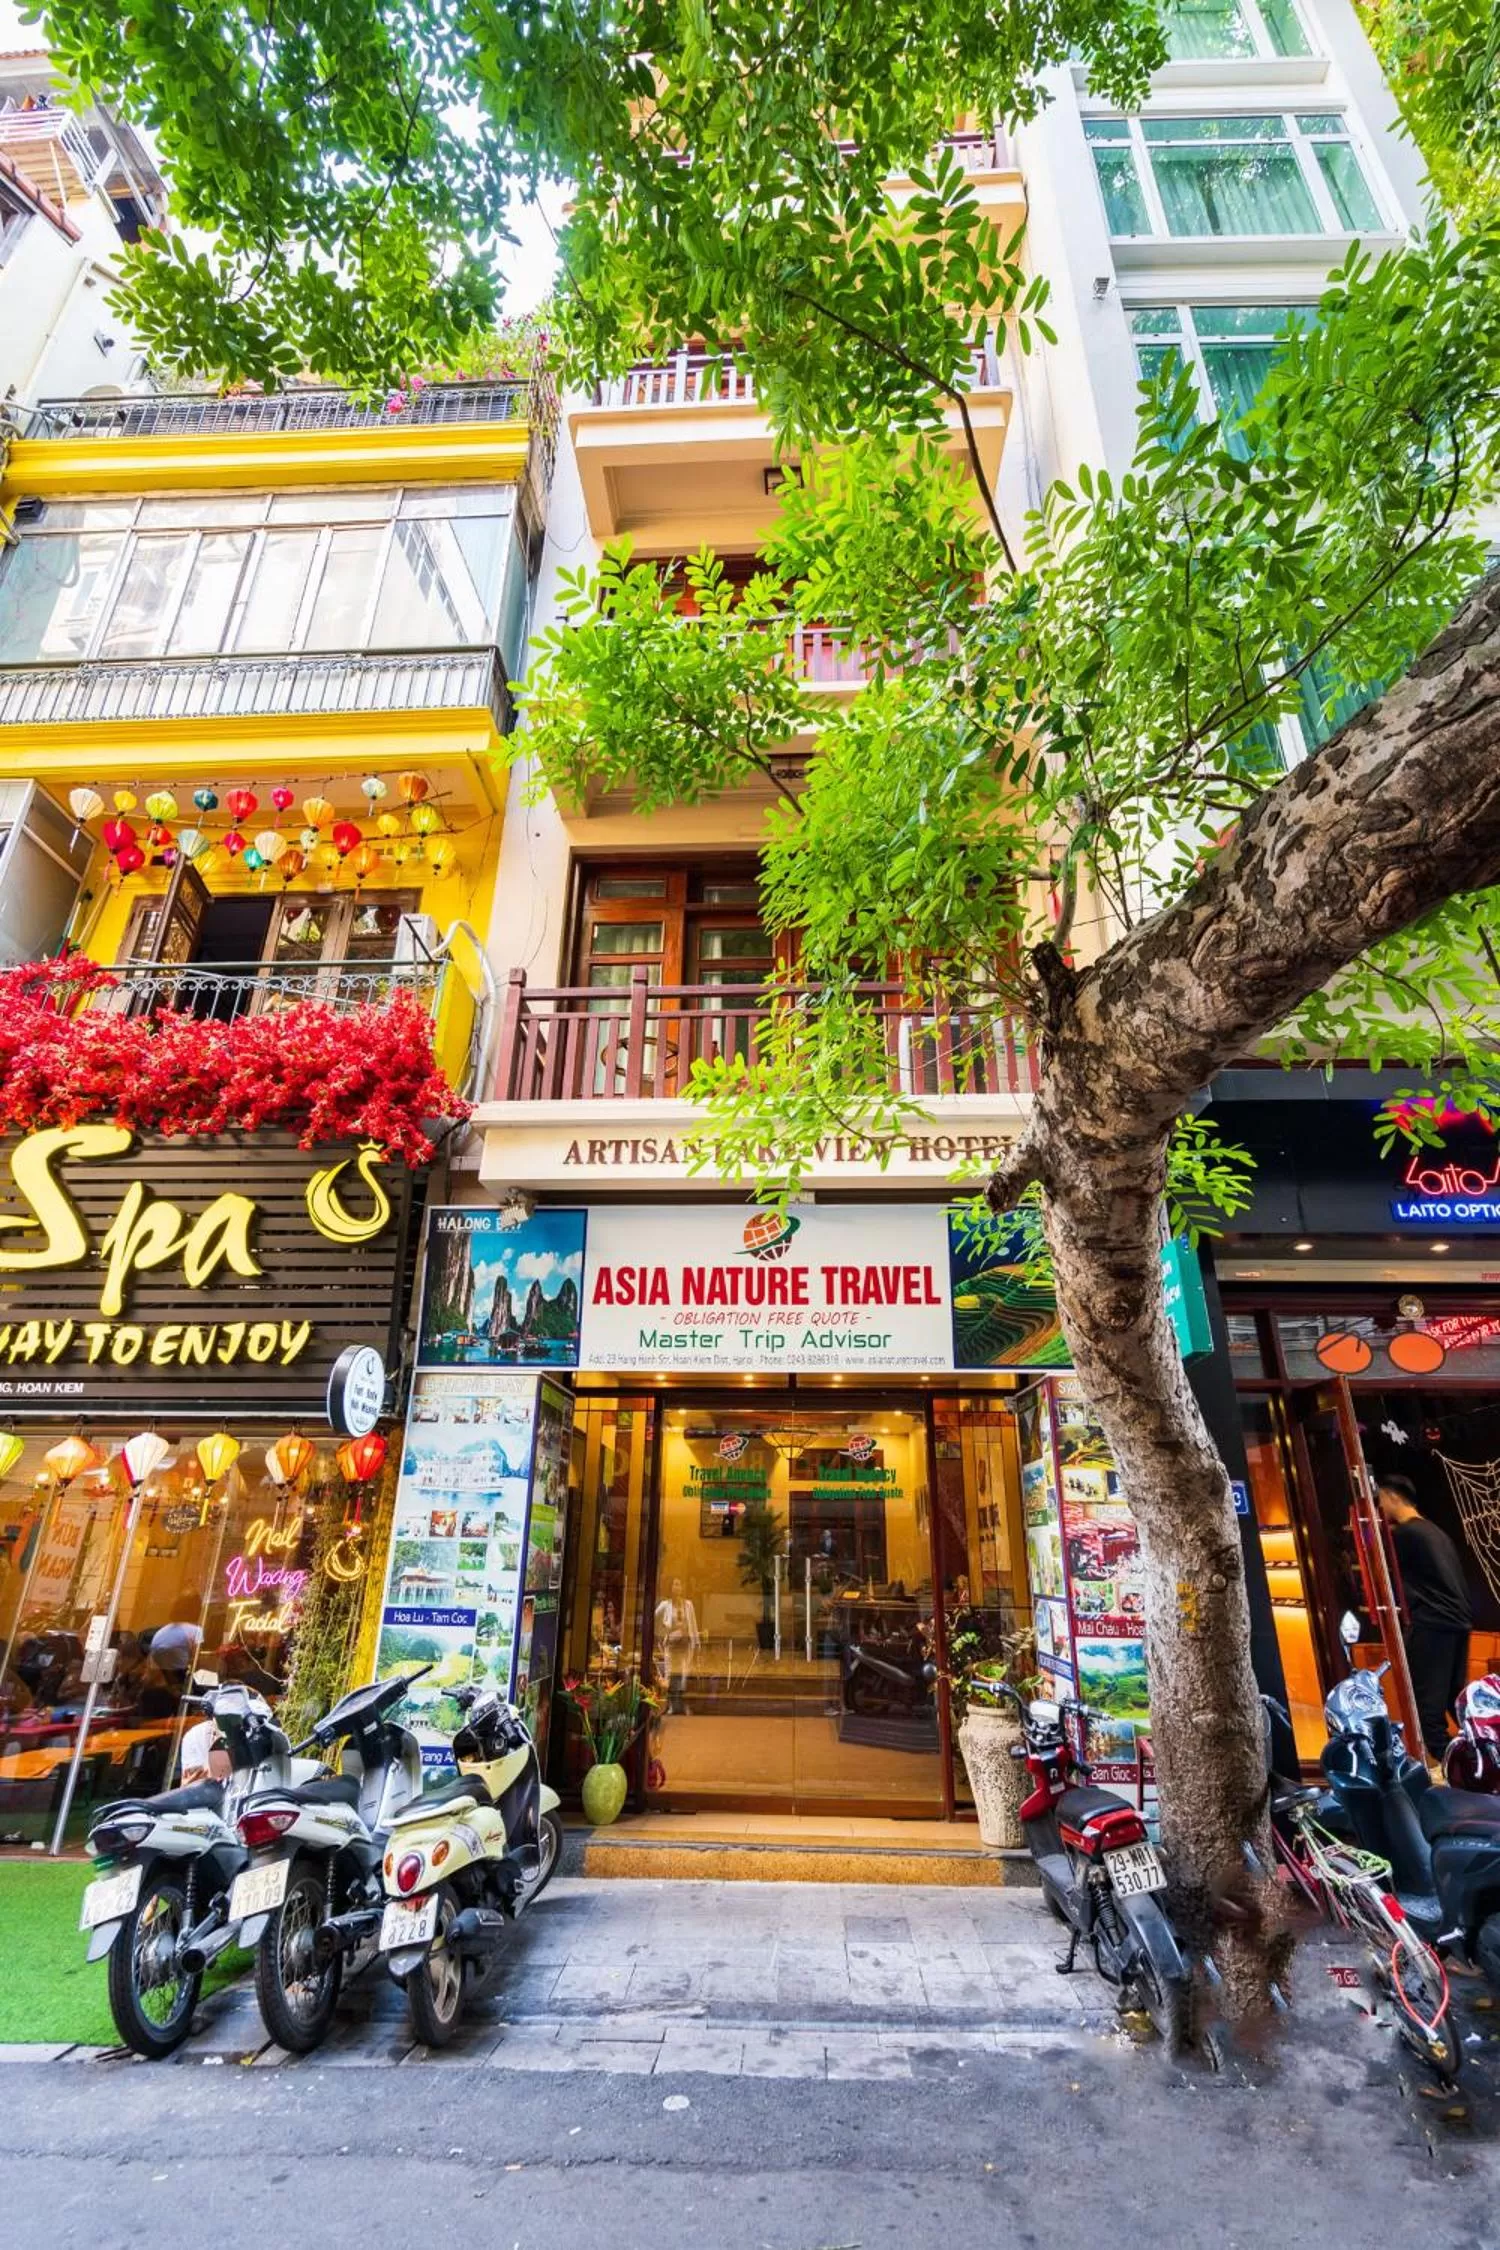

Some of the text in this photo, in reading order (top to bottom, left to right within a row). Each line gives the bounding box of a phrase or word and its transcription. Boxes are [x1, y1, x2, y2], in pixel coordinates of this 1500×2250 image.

[563, 1138, 702, 1165] ARTISAN
[814, 1136, 895, 1162] VIEW
[0, 1124, 262, 1316] Spa
[1397, 1203, 1452, 1218] LAITO
[437, 1217, 491, 1231] HALONG
[592, 1265, 942, 1306] ASIA NATURE TRAVEL
[673, 1311, 860, 1327] OBLIGATION FREE QUOTE
[84, 1322, 144, 1366] TO
[150, 1319, 312, 1366] ENJOY
[639, 1329, 892, 1353] Master Trip Advisor
[16, 1382, 52, 1393] HOAN
[54, 1382, 84, 1393] KIEM
[244, 1516, 304, 1556] Nail
[226, 1555, 308, 1602] Waxing
[228, 1599, 294, 1641] Facial
[393, 1611, 468, 1624] Hoa Lu Tam Coc
[1077, 1622, 1095, 1635] Mai
[1096, 1622, 1120, 1636] Chau
[1091, 1766, 1109, 1780] Ban
[1111, 1766, 1131, 1781] Gioc
[1116, 1866, 1160, 1895] 530.77
